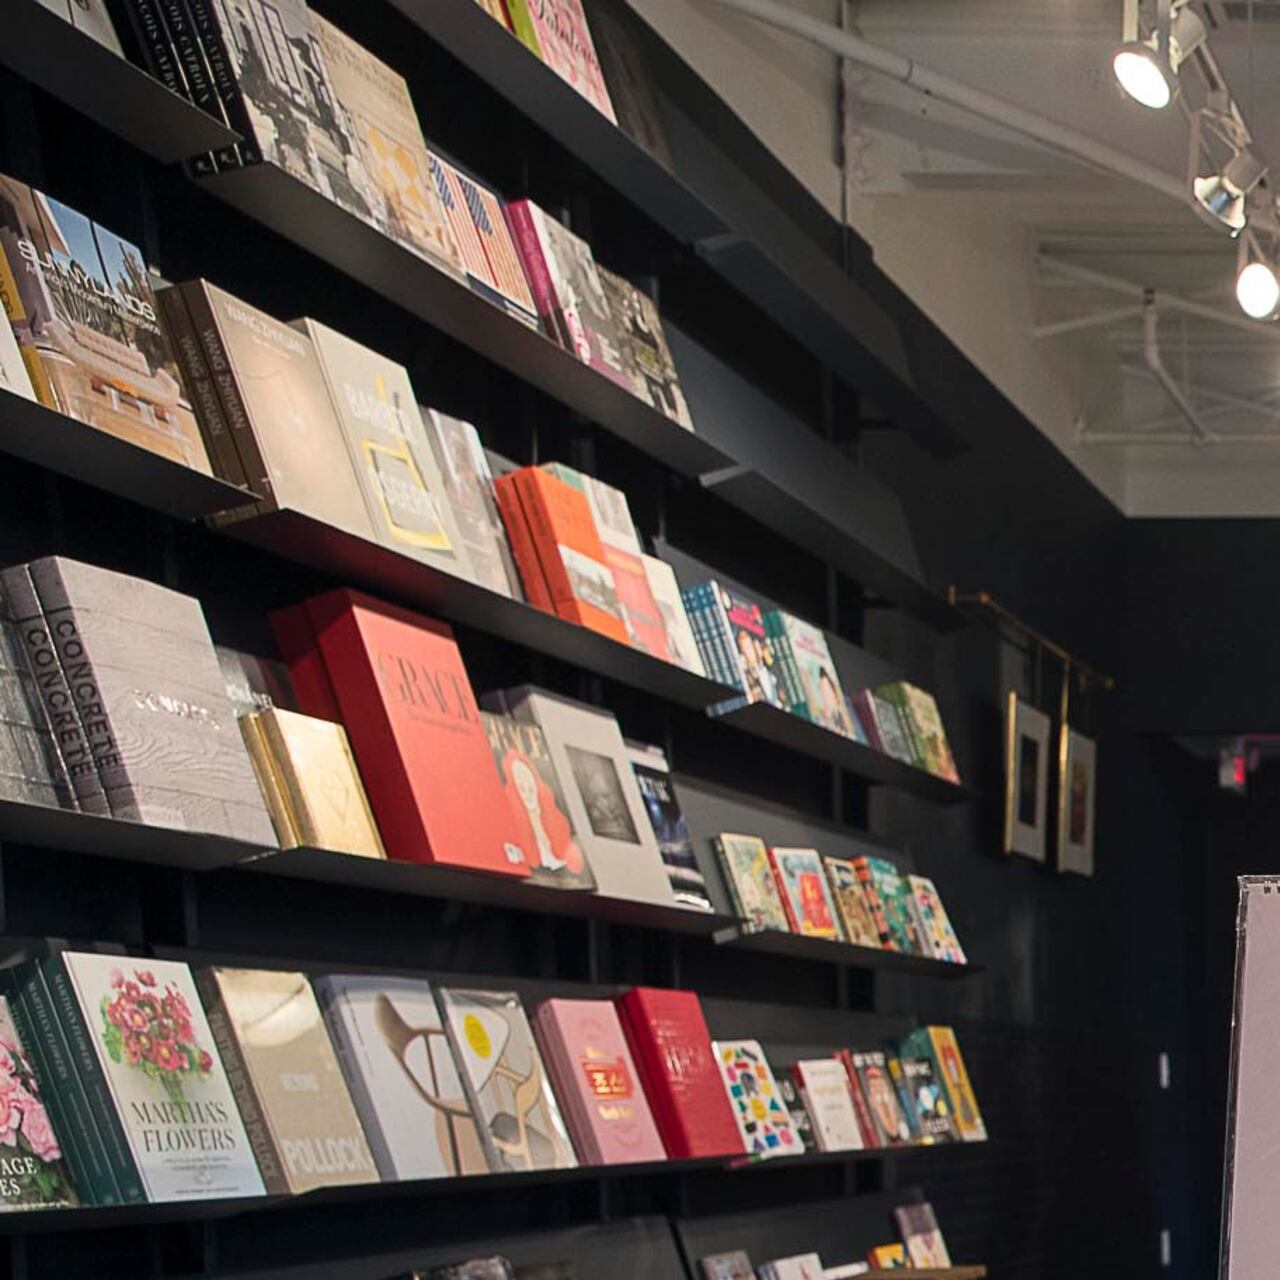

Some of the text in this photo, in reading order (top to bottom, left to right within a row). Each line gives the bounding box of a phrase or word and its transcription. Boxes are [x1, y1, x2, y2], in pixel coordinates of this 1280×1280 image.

[17, 239, 157, 322] SUNNYLANDS
[26, 628, 95, 778] CONCRETE
[55, 618, 120, 770] CONCRETE
[375, 652, 482, 726] GRACE
[488, 715, 549, 762] RACE
[130, 1100, 230, 1126] MARTHA'S
[141, 1127, 237, 1154] FLOWERS
[281, 1136, 369, 1175] POLLOCK
